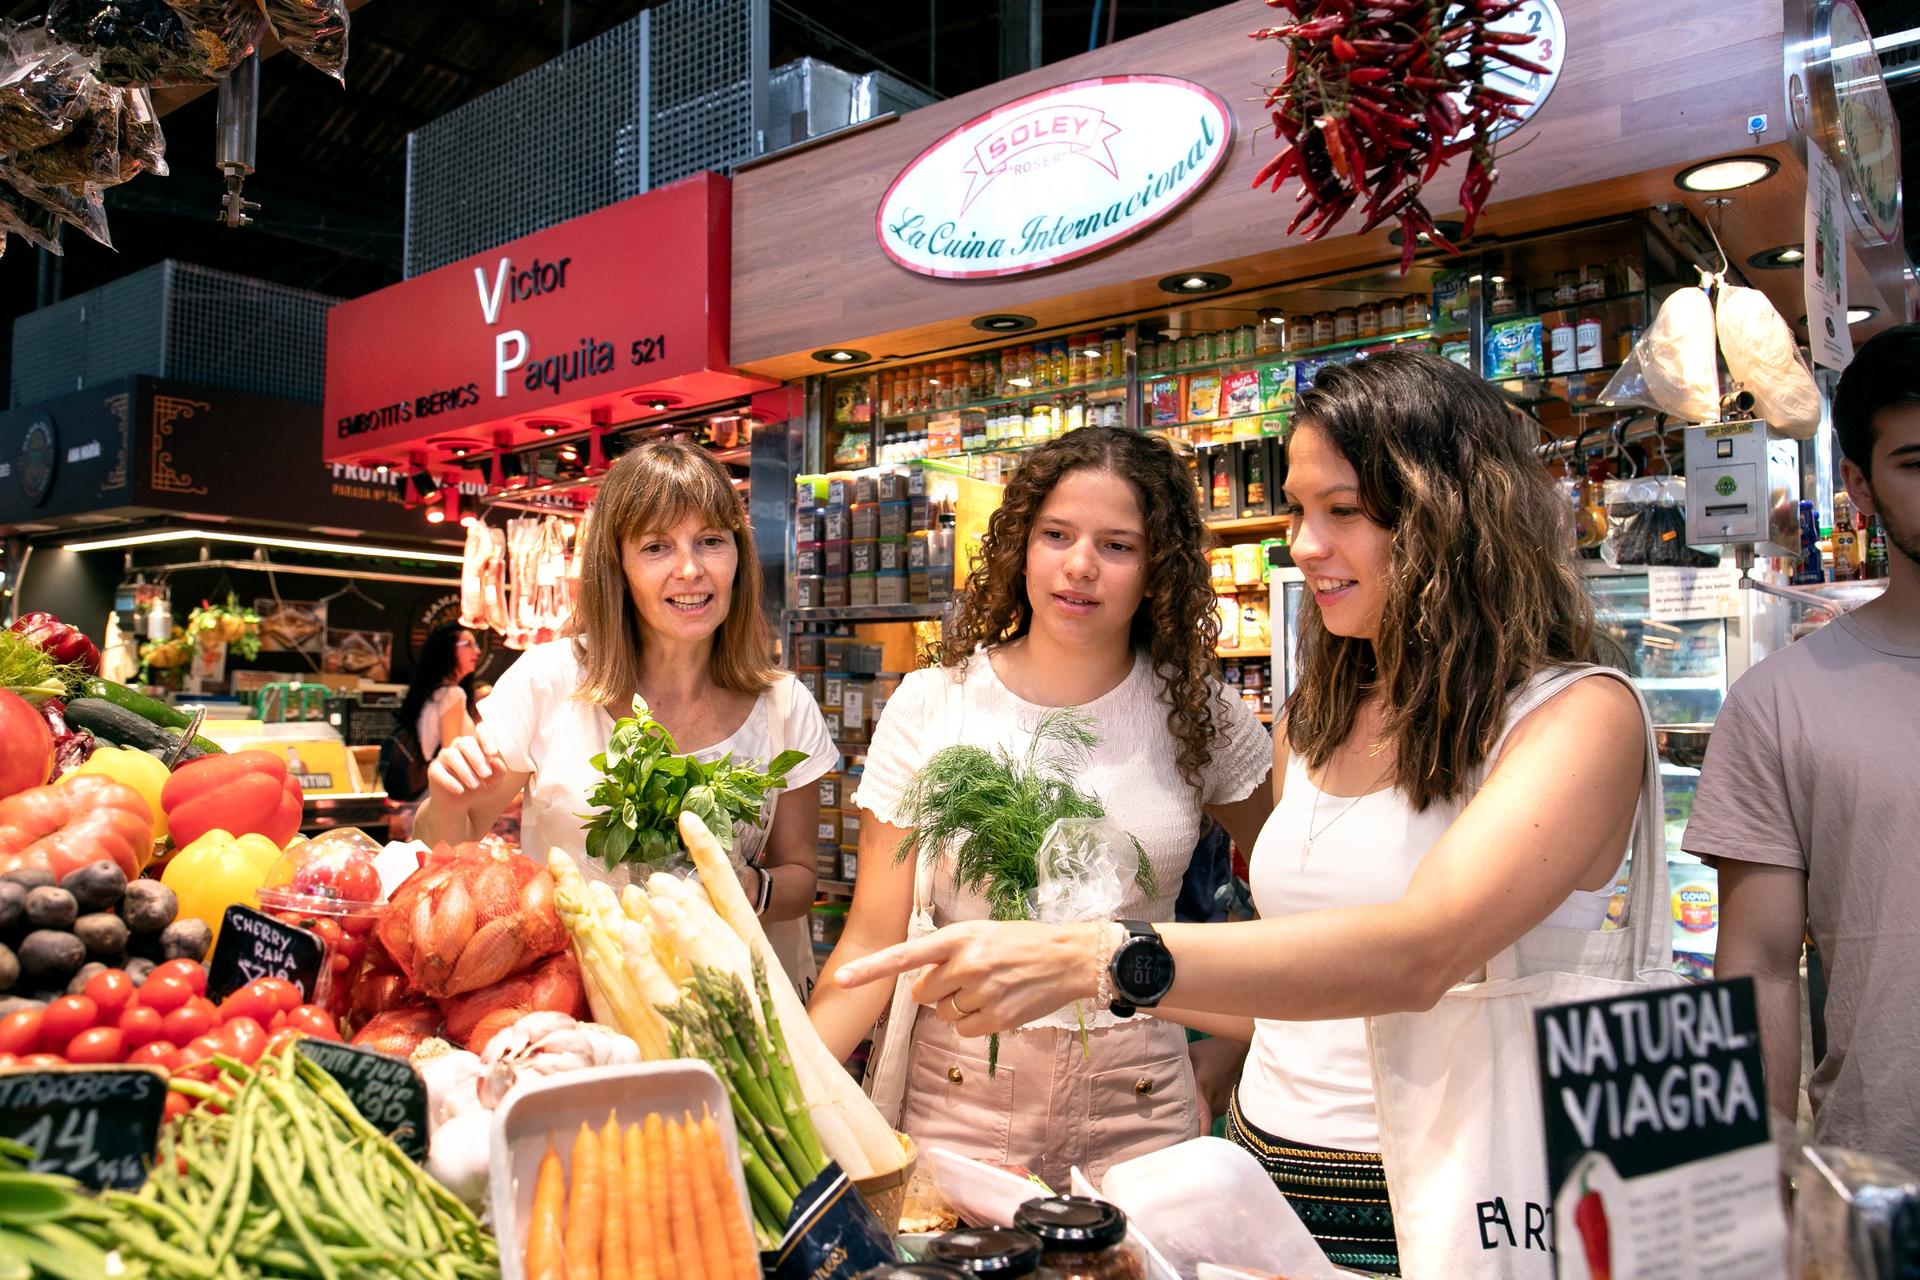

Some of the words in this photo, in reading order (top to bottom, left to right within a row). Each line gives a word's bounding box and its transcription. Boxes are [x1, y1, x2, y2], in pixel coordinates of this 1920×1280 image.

[1528, 10, 1542, 33] 2
[1538, 38, 1553, 62] 3
[988, 115, 1089, 160] SOLEY
[889, 206, 926, 250] La
[928, 221, 1006, 260] Cuina
[1010, 114, 1215, 256] Internacional
[474, 257, 572, 325] Victor
[495, 329, 615, 398] Paquita
[631, 335, 665, 366] 521
[337, 400, 413, 439] EMBOTITS
[1682, 892, 1711, 902] GOYA
[233, 914, 292, 952] CHERRY
[1544, 988, 1748, 1079] NATURAL
[1560, 1059, 1760, 1148] VIAGRA
